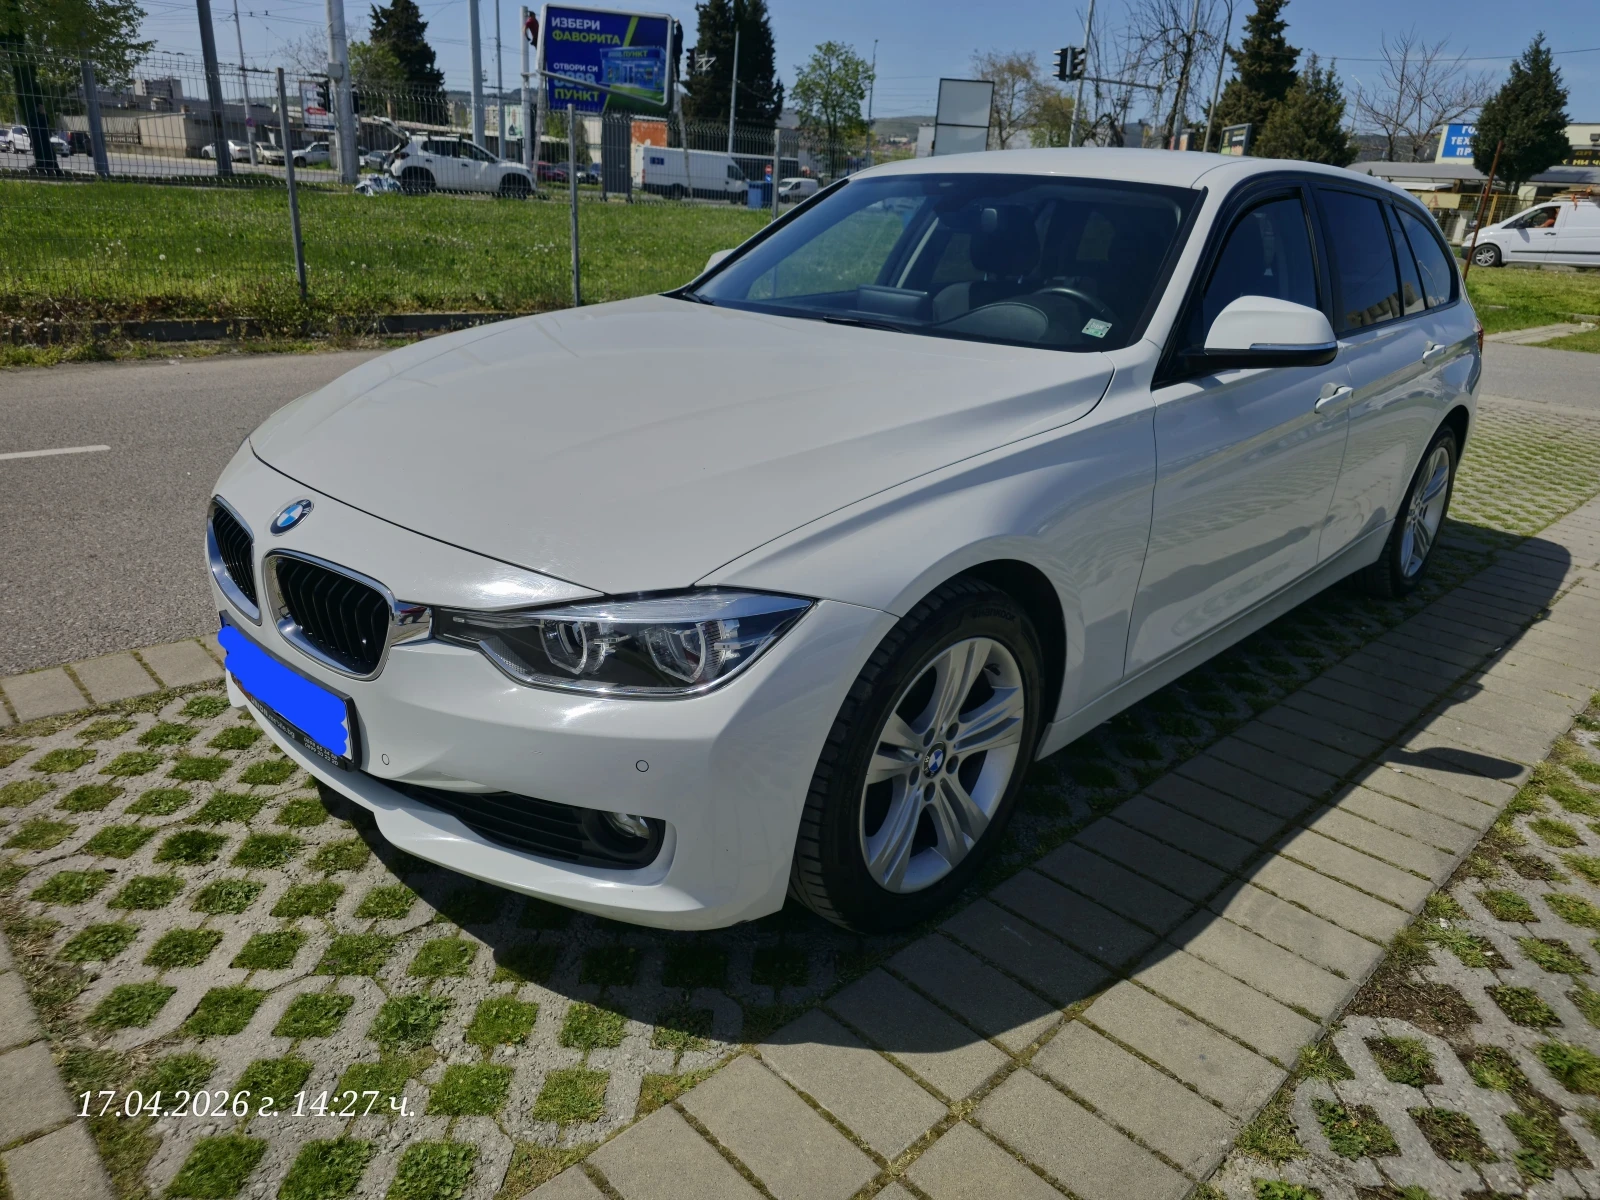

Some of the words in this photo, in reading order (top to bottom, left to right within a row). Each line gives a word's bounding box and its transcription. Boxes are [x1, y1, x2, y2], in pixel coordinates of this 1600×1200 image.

[551, 16, 600, 30] ИЗБЕРИ
[552, 30, 621, 45] ФАВОРИТА
[553, 62, 586, 72] ОТВОРИ
[554, 88, 599, 102] ПУНКТ
[1461, 125, 1478, 135] ГО
[1451, 136, 1472, 145] ТЕХ
[1456, 147, 1472, 156] ПР
